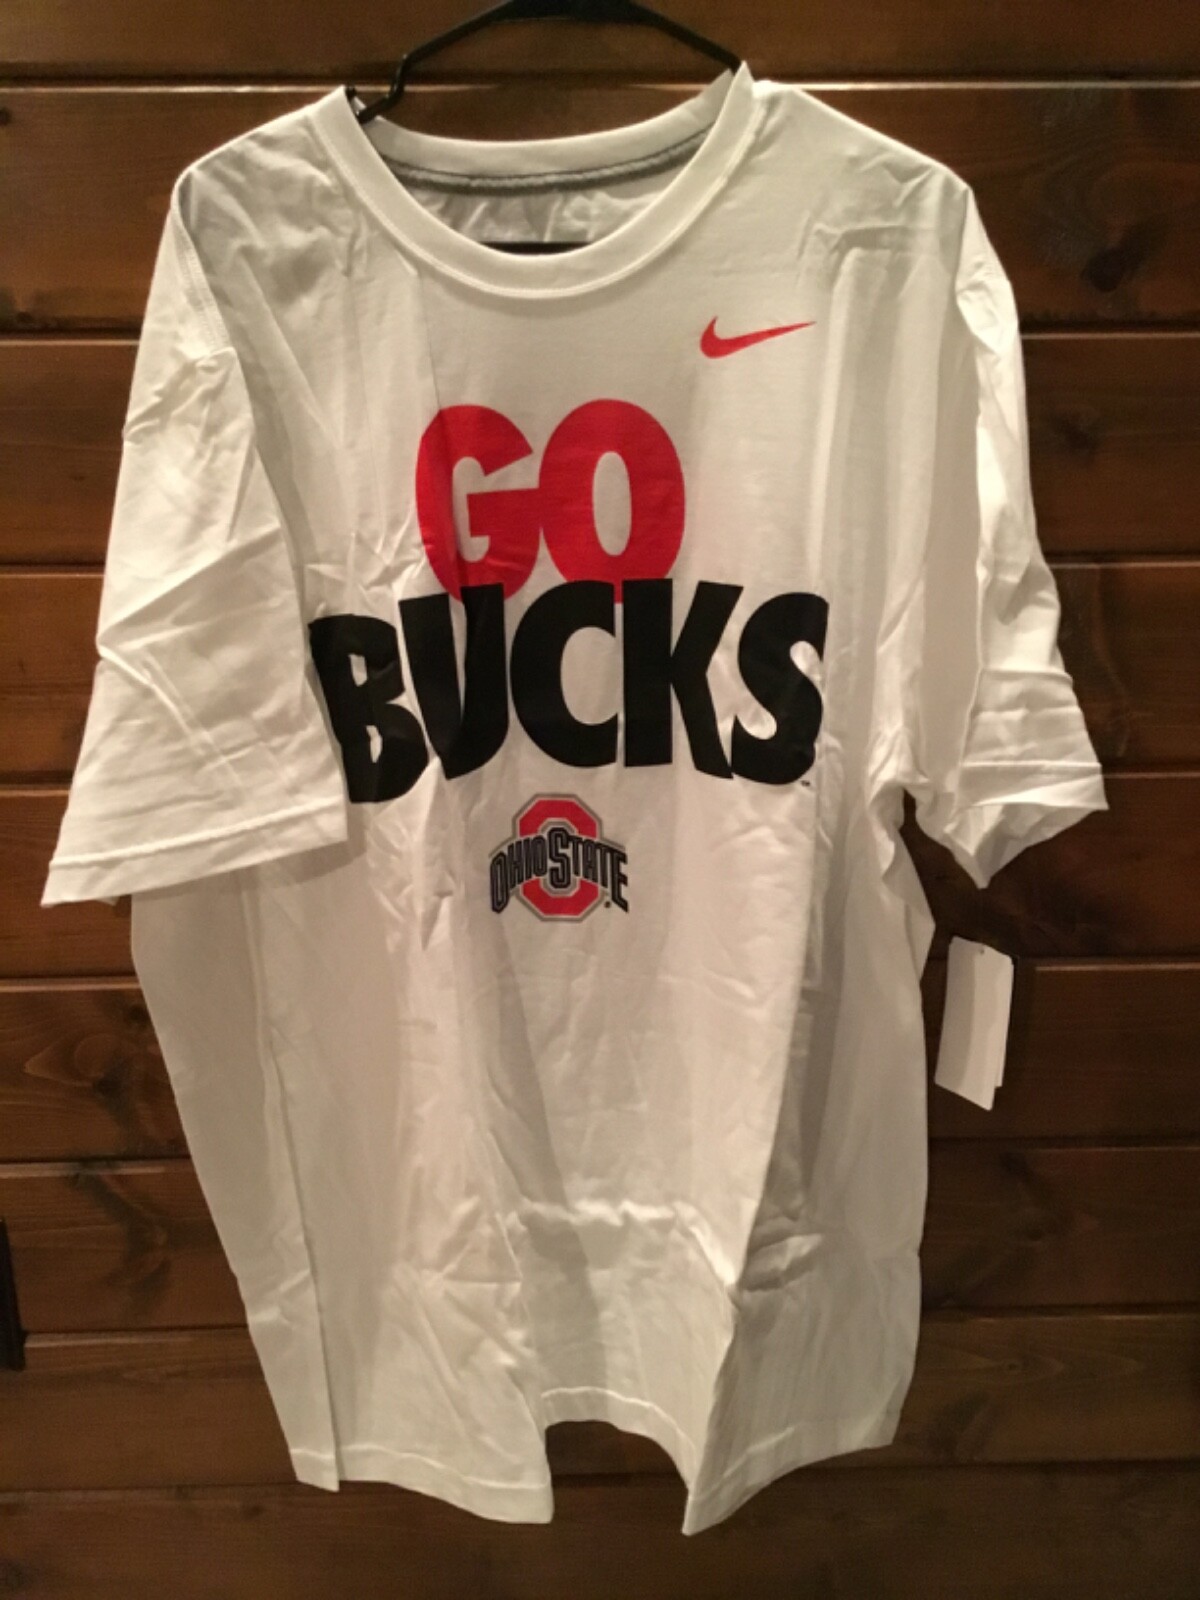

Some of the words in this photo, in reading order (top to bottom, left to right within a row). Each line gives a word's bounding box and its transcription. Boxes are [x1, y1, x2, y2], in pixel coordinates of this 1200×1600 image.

[415, 398, 685, 604] GO
[308, 578, 829, 804] BUCKS
[489, 835, 549, 914] OHIO
[547, 827, 629, 913] STATE
